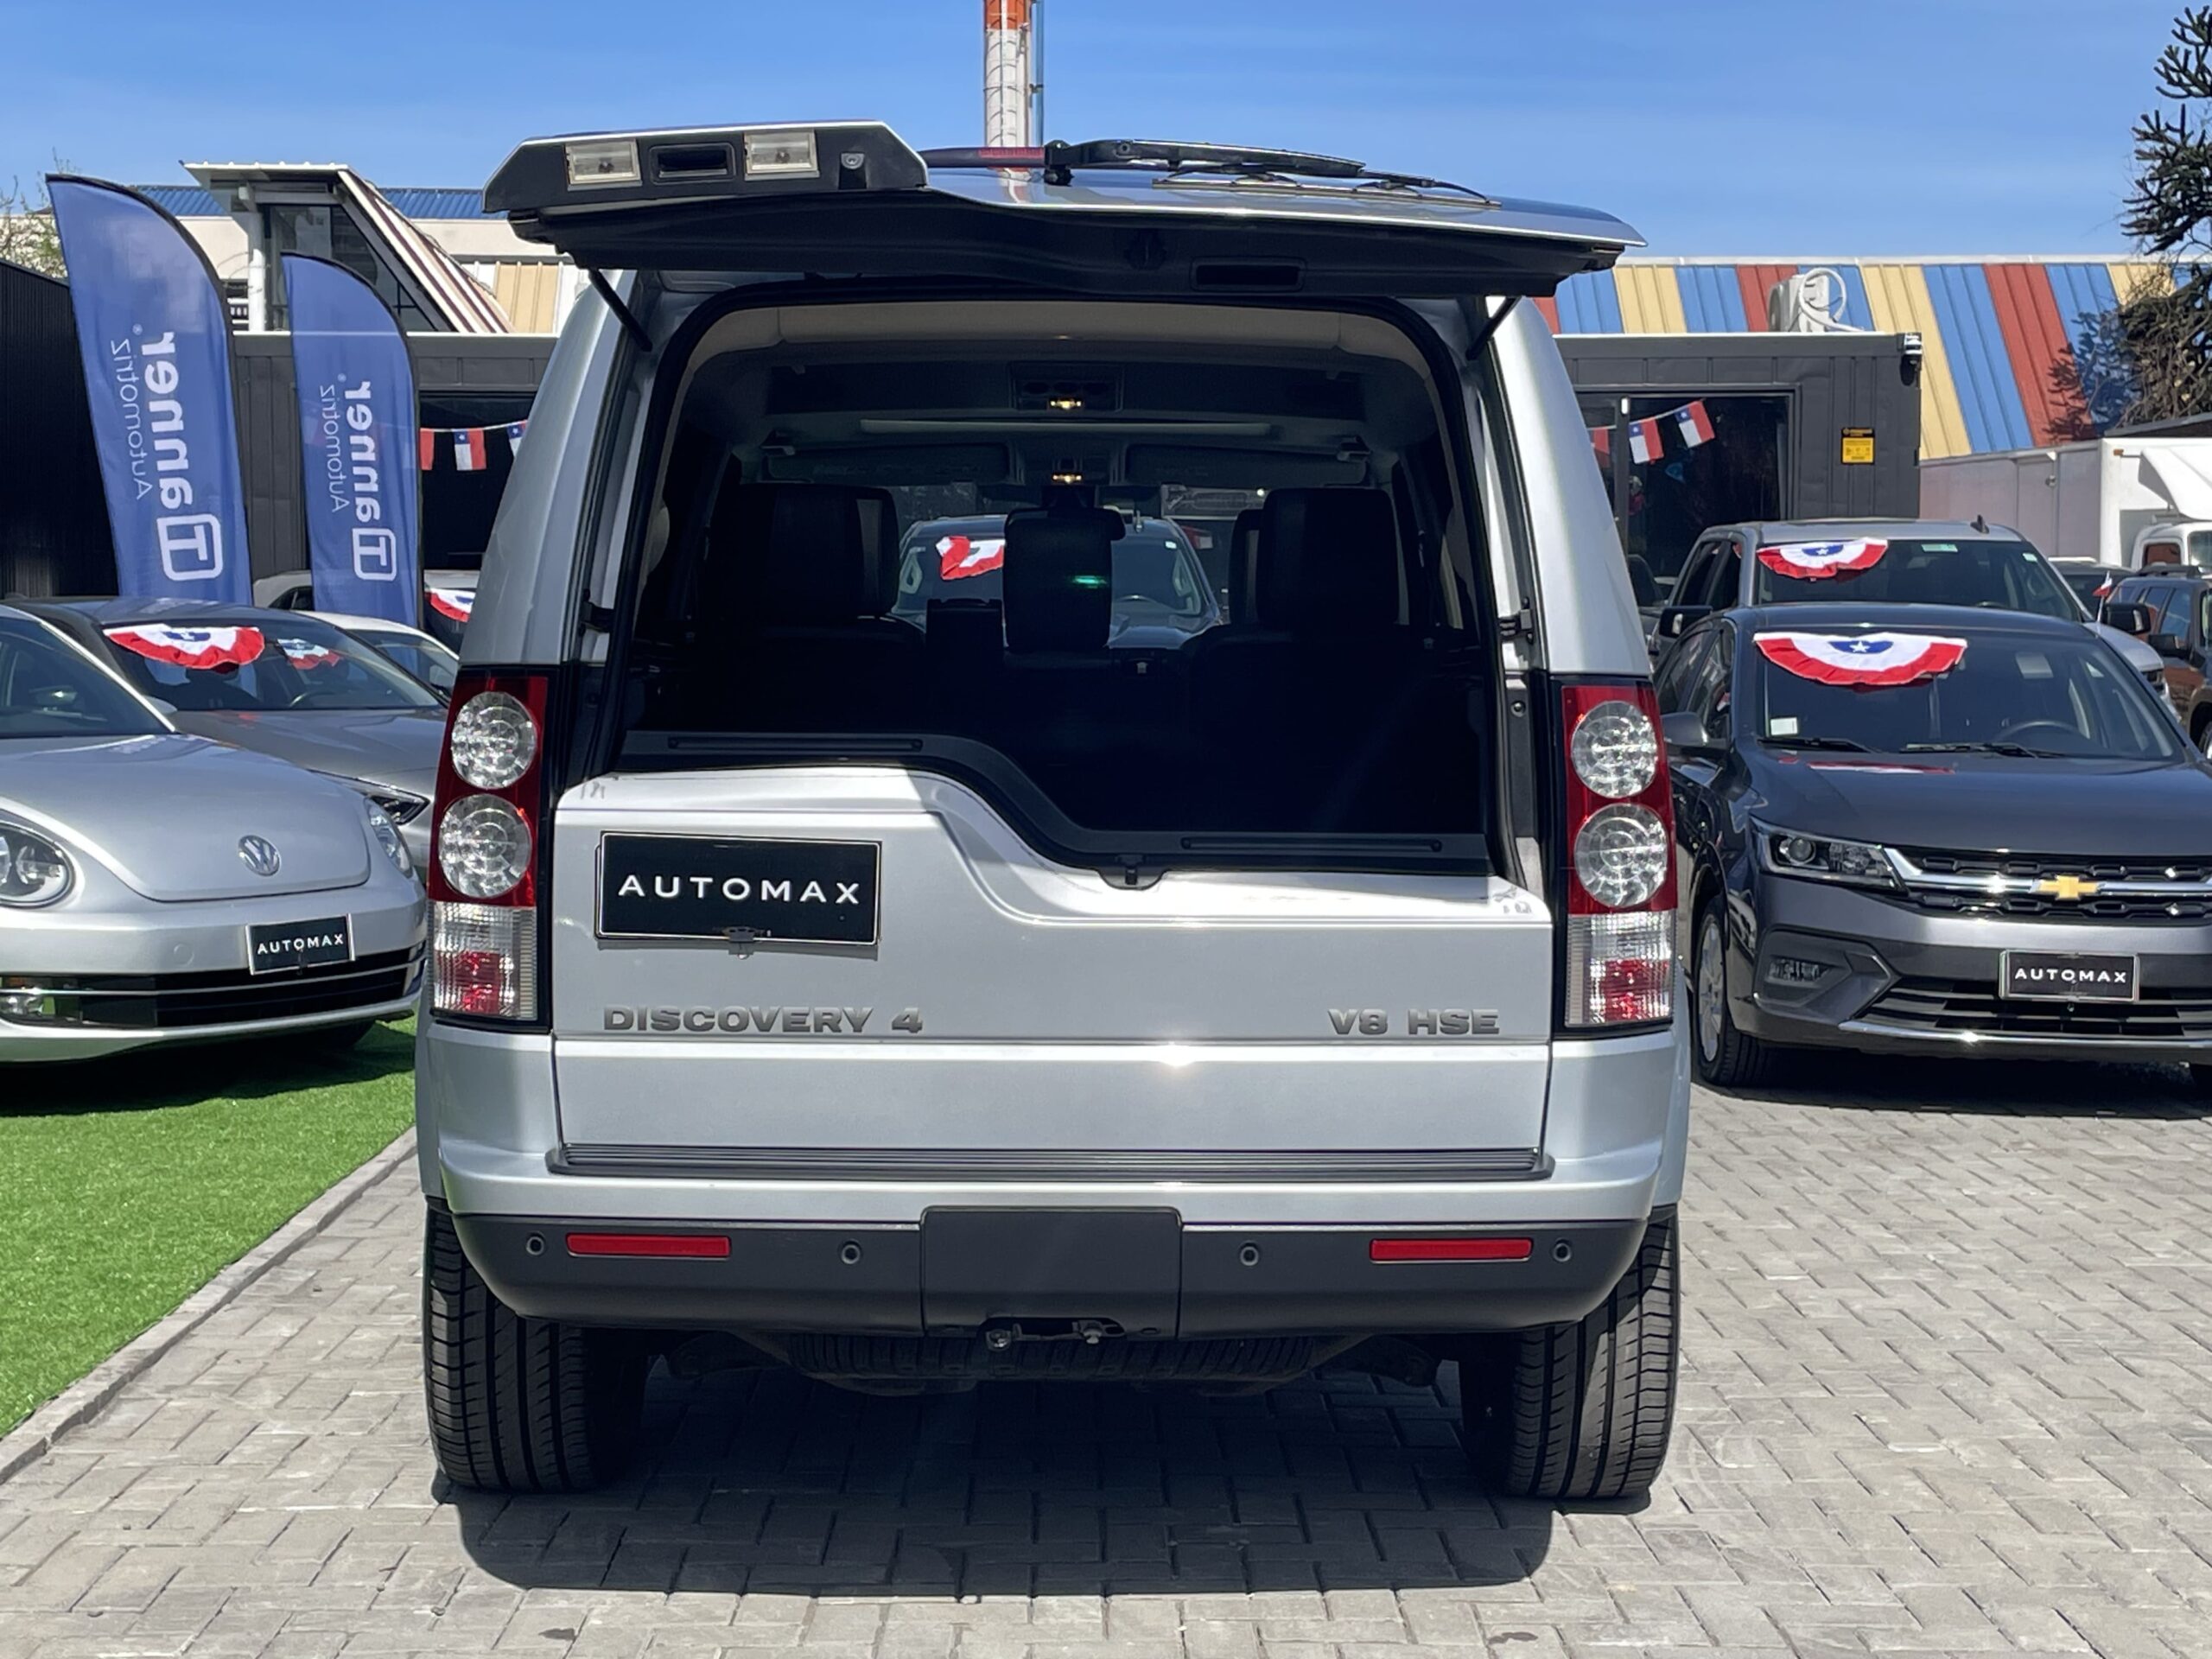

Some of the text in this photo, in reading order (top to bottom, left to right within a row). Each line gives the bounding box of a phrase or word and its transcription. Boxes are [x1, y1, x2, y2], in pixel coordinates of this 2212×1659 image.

[617, 874, 860, 905] AUTOMAX
[257, 933, 344, 956] AUTOMAX
[2014, 967, 2127, 984] AUTOMAX
[604, 1004, 924, 1034] DISCOVERY 4
[1327, 1007, 1500, 1035] V8 HSE
